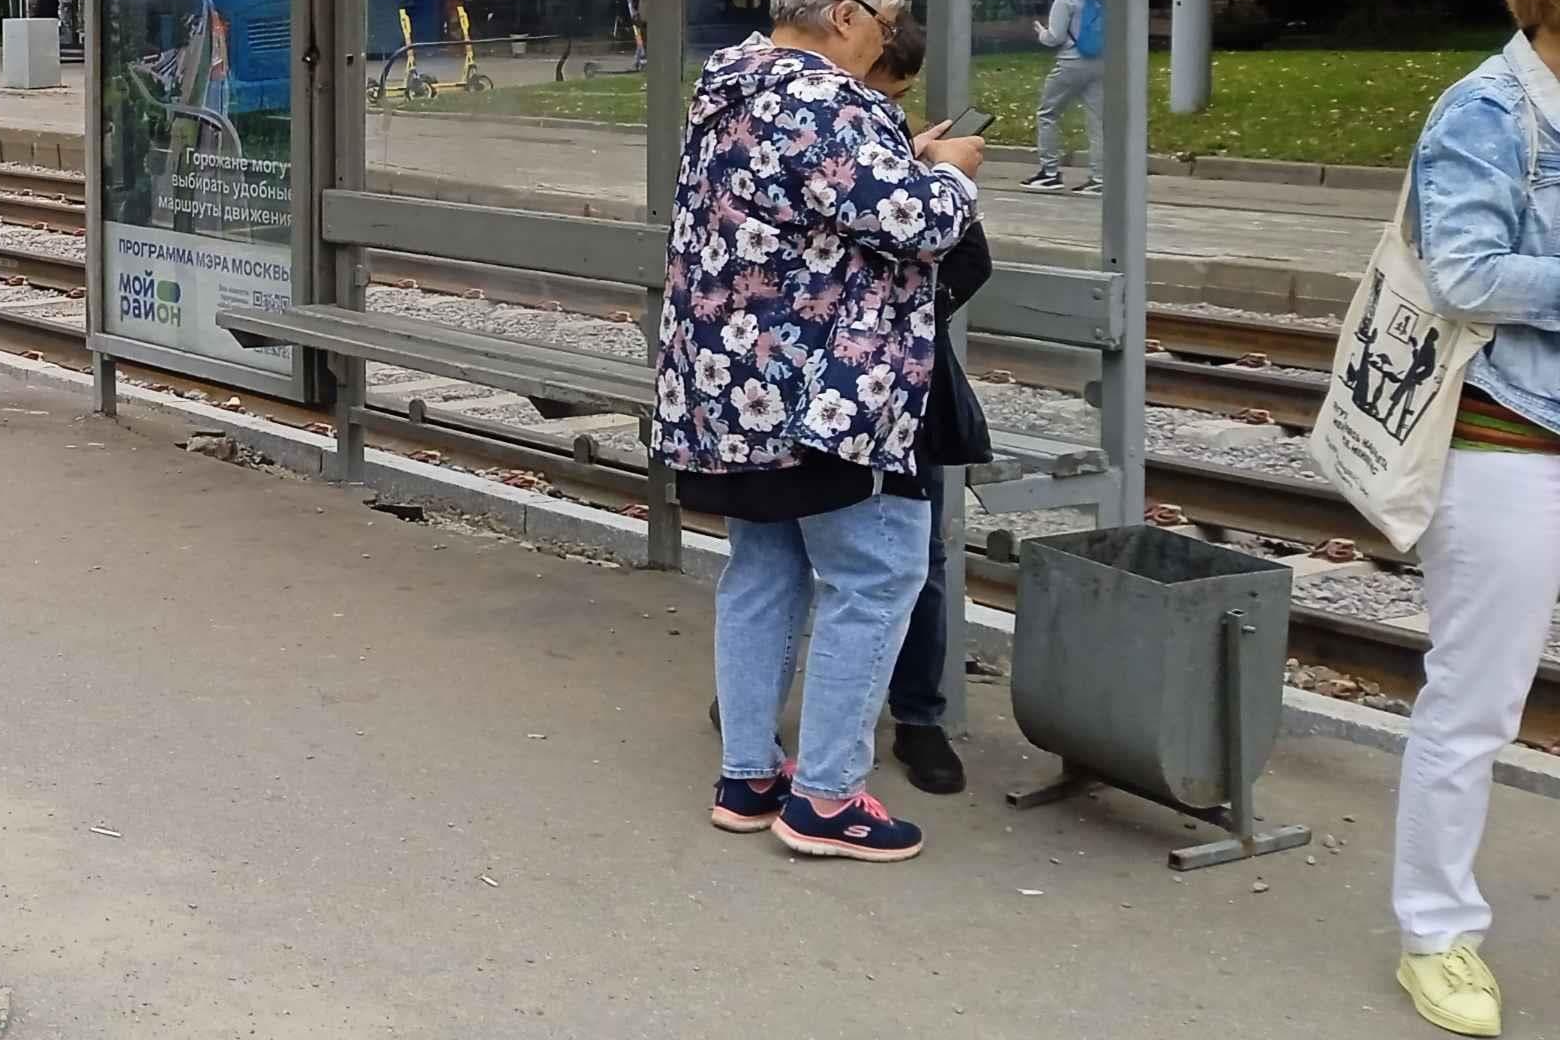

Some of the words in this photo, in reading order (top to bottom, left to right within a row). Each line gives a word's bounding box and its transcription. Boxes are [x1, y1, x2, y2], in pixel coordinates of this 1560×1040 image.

[186, 147, 248, 171] Горожане
[172, 172, 230, 195] выбирать
[158, 195, 221, 218] маршруты
[119, 238, 193, 266] ПРОГРАММА
[196, 251, 230, 273] МЭРА
